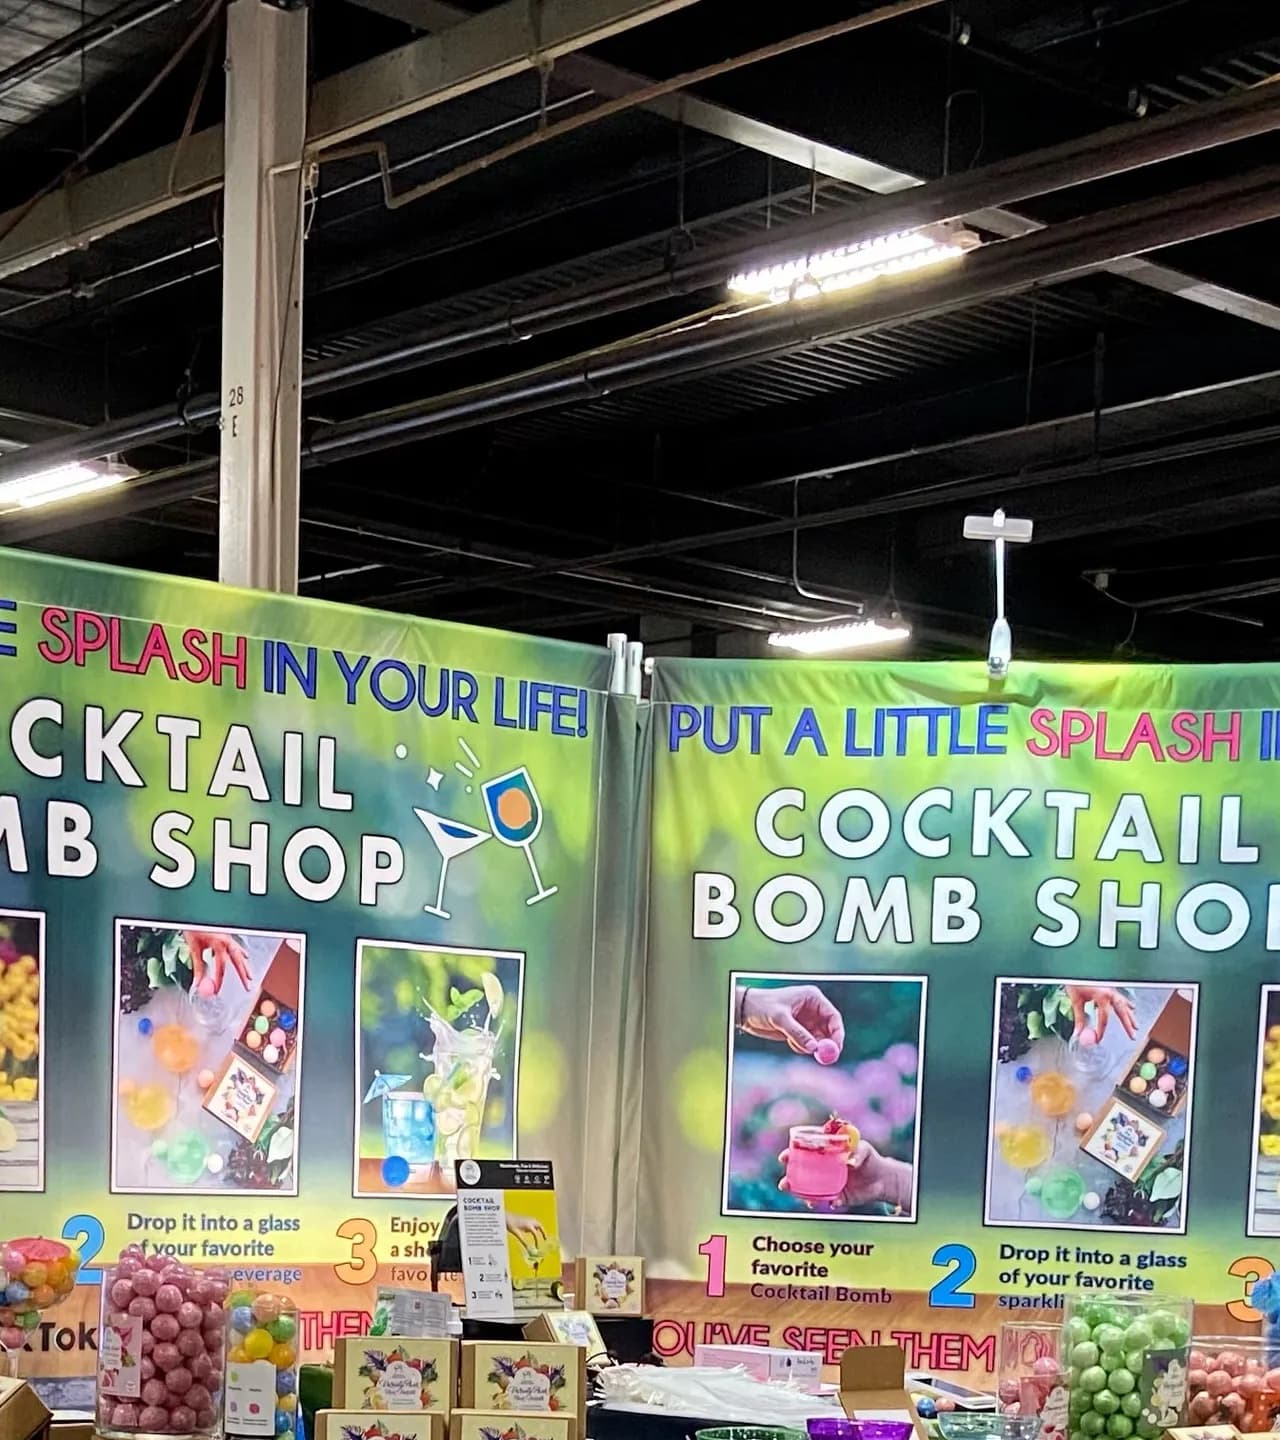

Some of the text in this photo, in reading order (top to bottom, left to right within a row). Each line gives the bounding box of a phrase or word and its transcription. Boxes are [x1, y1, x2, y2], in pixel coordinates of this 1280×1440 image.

[229, 386, 244, 407] 28
[37, 606, 247, 689] SPLASH
[263, 640, 317, 700] IN
[333, 650, 479, 723] YOUR
[494, 676, 588, 739] LIFE!
[669, 703, 772, 754] PUT
[785, 707, 828, 756] A
[845, 704, 1008, 757] LITTLE
[1025, 708, 1242, 762] SPLASH
[754, 787, 1260, 865] COCKTAIL
[149, 810, 405, 906] SHOP
[692, 871, 982, 945] BOMB
[127, 1213, 300, 1234] Drop it into a glass
[390, 1217, 439, 1235] Enjoy
[61, 1214, 105, 1285] 2
[152, 1243, 197, 1258] your
[201, 1240, 275, 1257] favorite
[334, 1218, 377, 1286] 3
[390, 1245, 400, 1257] a
[752, 1236, 874, 1257] Choose your
[1000, 1244, 1187, 1269] Drop it into a glass
[229, 1267, 302, 1284] everage
[698, 1234, 727, 1297] 1
[751, 1260, 828, 1278] favorite
[929, 1243, 977, 1309] 2
[999, 1268, 1154, 1292] of your favorite
[751, 1283, 892, 1304] Cocktail Bomb
[1226, 1256, 1276, 1322] 3
[891, 1330, 997, 1373] THEM
